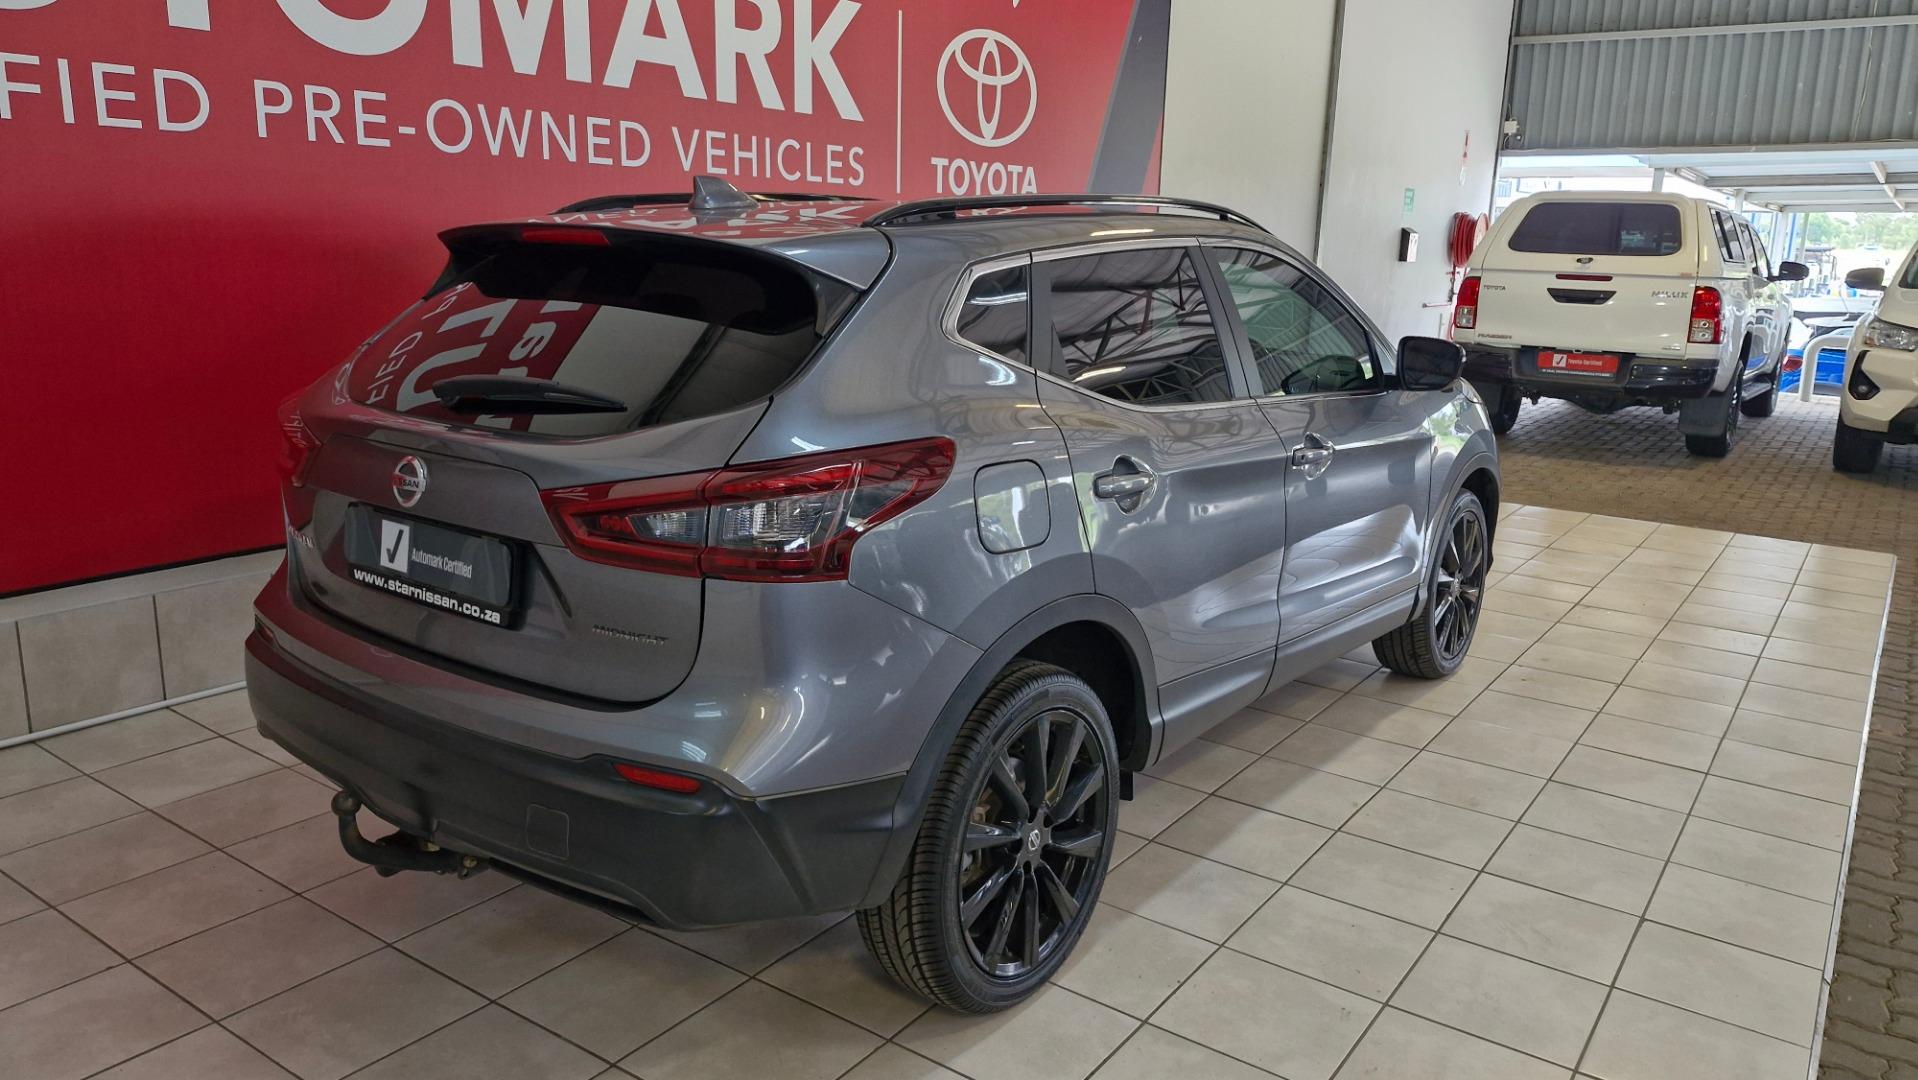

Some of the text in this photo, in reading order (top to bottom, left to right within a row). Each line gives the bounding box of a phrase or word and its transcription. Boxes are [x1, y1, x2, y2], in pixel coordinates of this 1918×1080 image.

[0, 52, 865, 187] FIED PRE-OWNED VEHICLES
[931, 157, 1037, 197] TOYOTA
[411, 548, 473, 579] Automark Certified
[353, 568, 501, 624] www.starnissan.co.za
